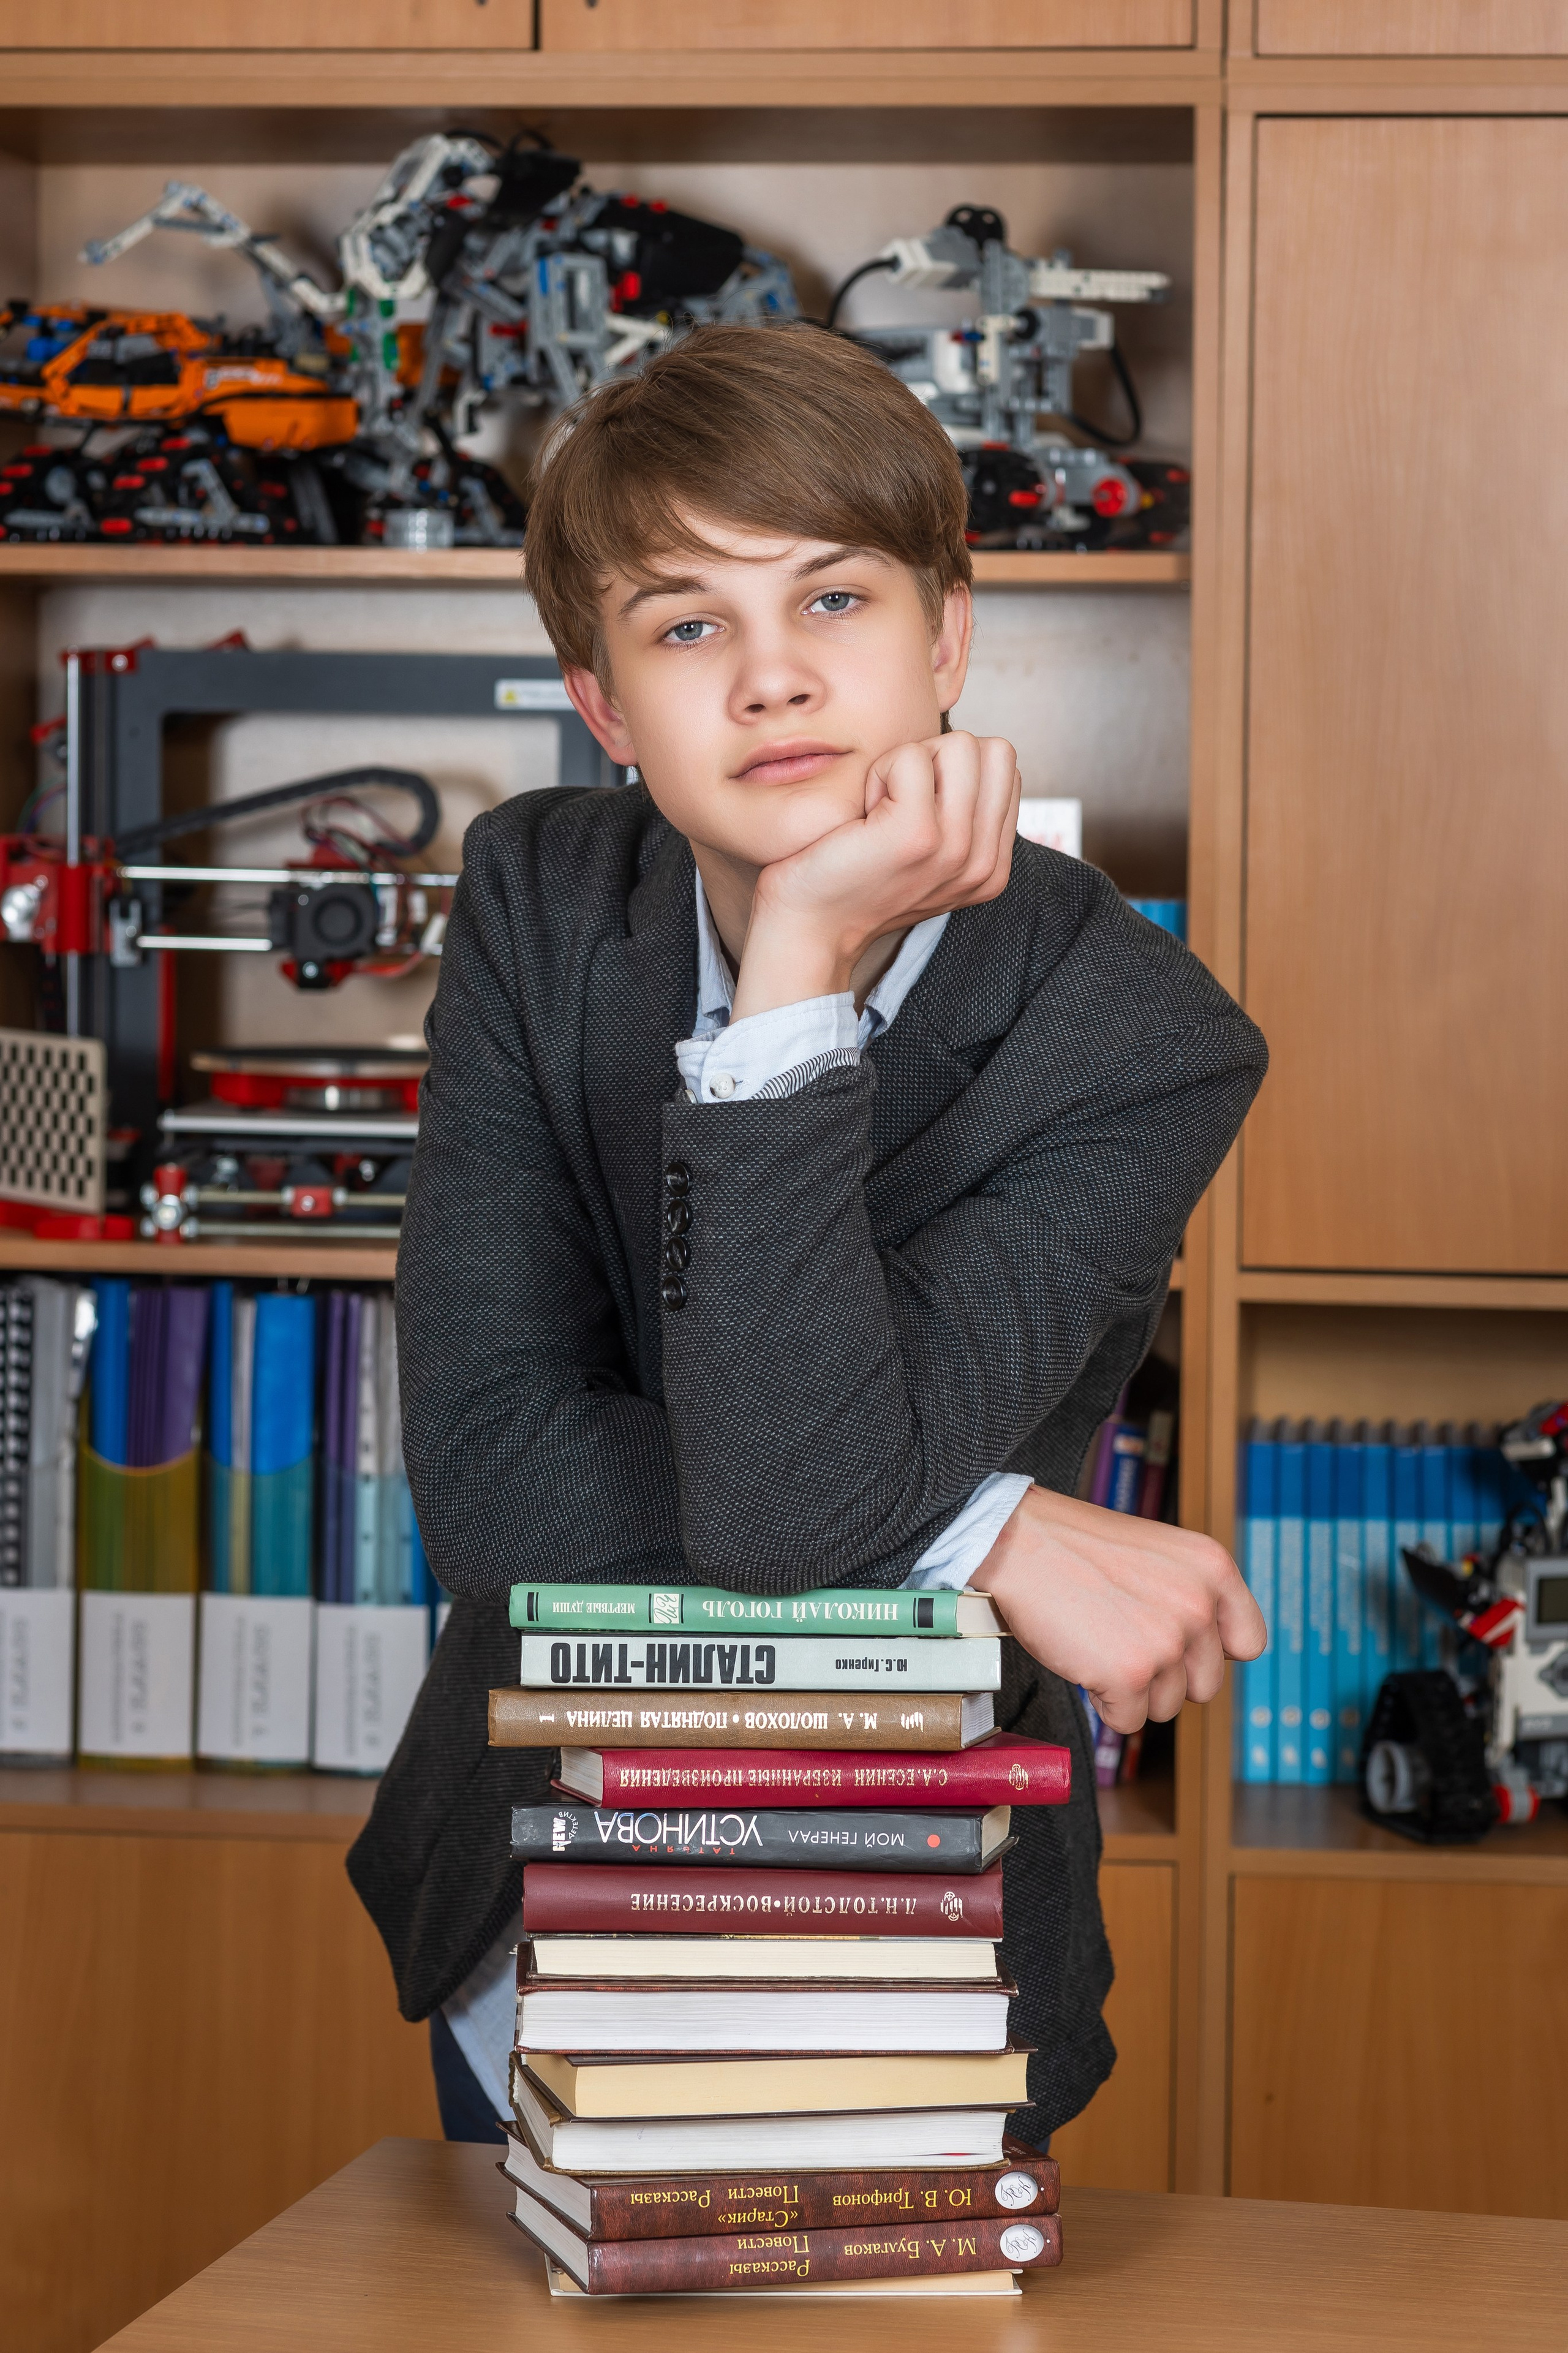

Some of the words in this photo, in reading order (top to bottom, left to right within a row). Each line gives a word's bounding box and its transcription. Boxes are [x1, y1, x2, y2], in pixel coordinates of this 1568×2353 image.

[553, 1600, 583, 1612] ДУШИ
[587, 1603, 635, 1613] МЕРТВЫЕ
[703, 1600, 782, 1618] ГОГОЛЬ
[793, 1603, 898, 1624] НИКОЛАЙ
[551, 1643, 775, 1684] СТАЛИН-ТИТО
[566, 1711, 632, 1729] ЦЕЛИНА
[641, 1712, 728, 1730] ПОДНЯТАЯ
[745, 1712, 828, 1730] ШОЛОХОВ
[839, 1713, 854, 1730] А.
[858, 1713, 879, 1730] М.
[619, 1769, 743, 1789] ПРОИЗВЕДЕНИЯ
[748, 1769, 842, 1789] ИЗБРАННЫЕ
[552, 1818, 571, 1851] NEW
[557, 1811, 578, 1840] ДЕТЕКТИВ
[594, 1811, 763, 1847] УСТИНОВА
[788, 1830, 857, 1844] ГЕНЕРАЛ
[865, 1833, 903, 1847] МОЙ
[632, 1845, 736, 1855] ТАТЬЯНА
[631, 2190, 710, 2207] Рассказы
[728, 2186, 798, 2203] Повести
[833, 2189, 913, 2209] Трифонов
[921, 2191, 937, 2207] В.
[945, 2189, 971, 2206] Ю.
[718, 2208, 797, 2227] «Старик»
[736, 2234, 809, 2253] Повести
[845, 2240, 919, 2258] Булгаков
[927, 2240, 946, 2256] А.
[953, 2238, 976, 2255] М.
[730, 2260, 810, 2276] Рассказы
